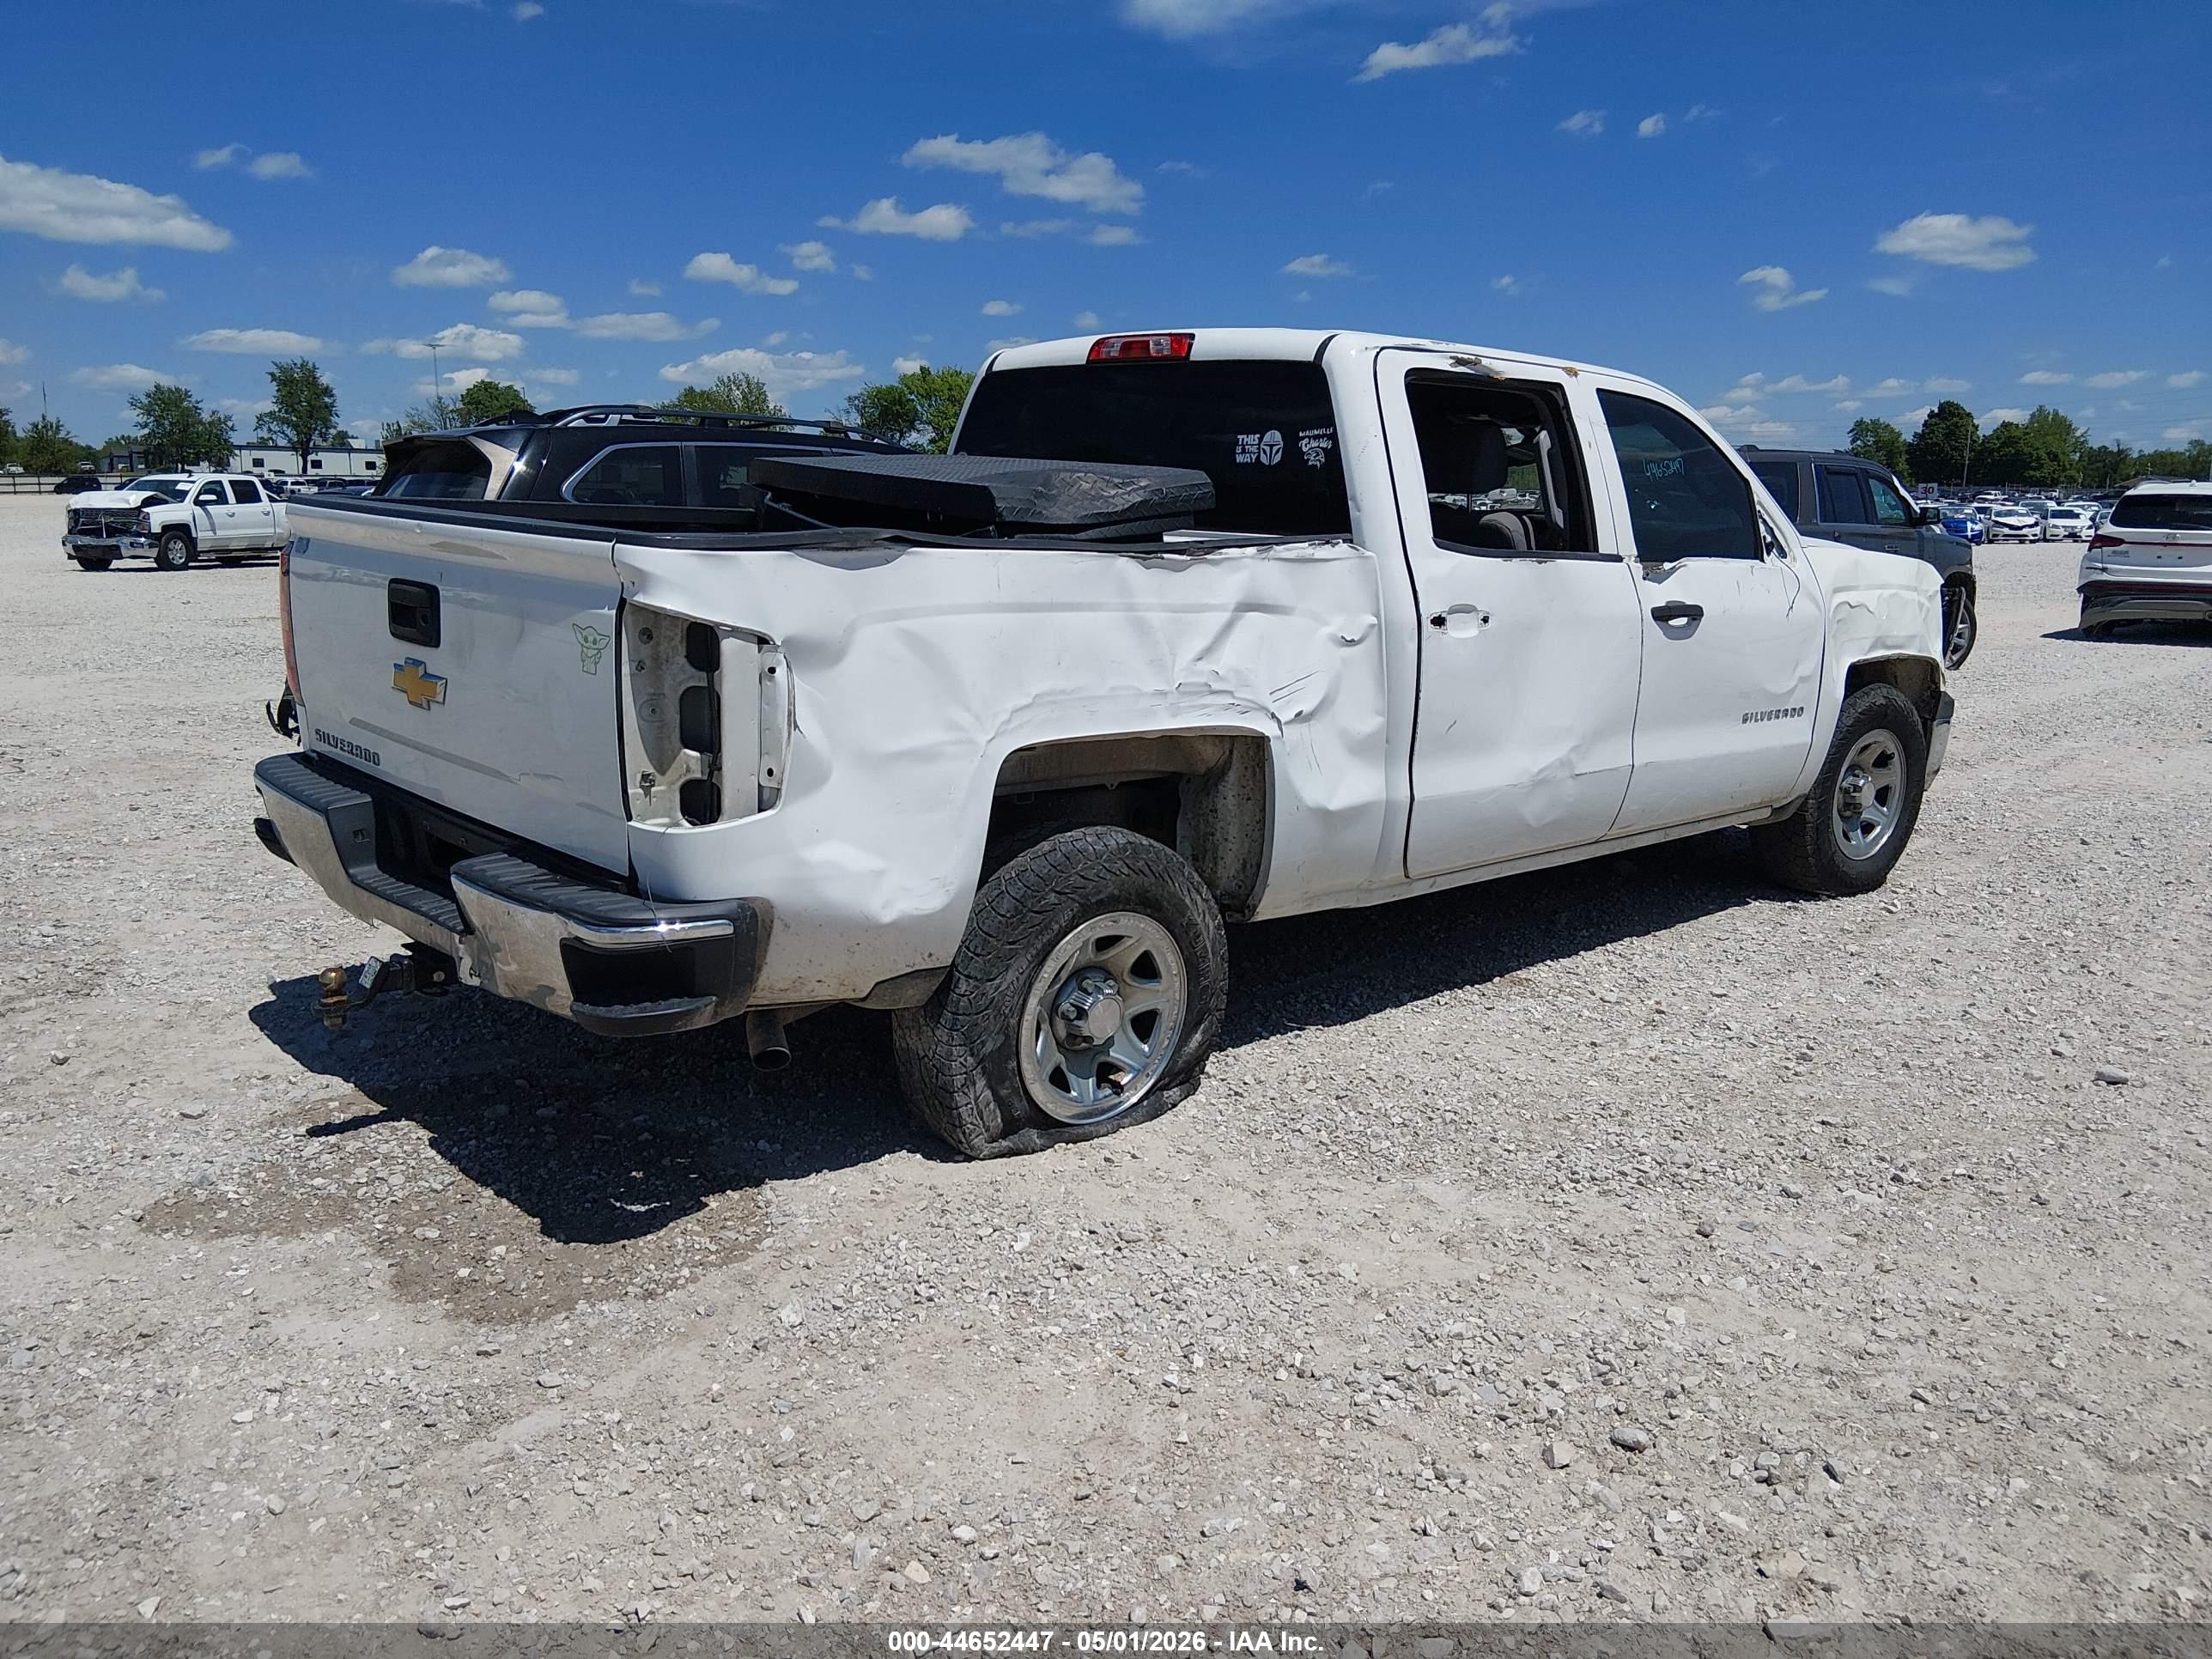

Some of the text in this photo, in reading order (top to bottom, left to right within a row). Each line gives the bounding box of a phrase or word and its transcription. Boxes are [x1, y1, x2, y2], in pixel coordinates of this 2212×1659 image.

[1237, 434, 1260, 445] THIS
[1236, 453, 1258, 463] WAY
[1921, 486, 1935, 495] 30
[1741, 706, 1804, 725] SILVERADO
[314, 728, 380, 767] SILVERADO
